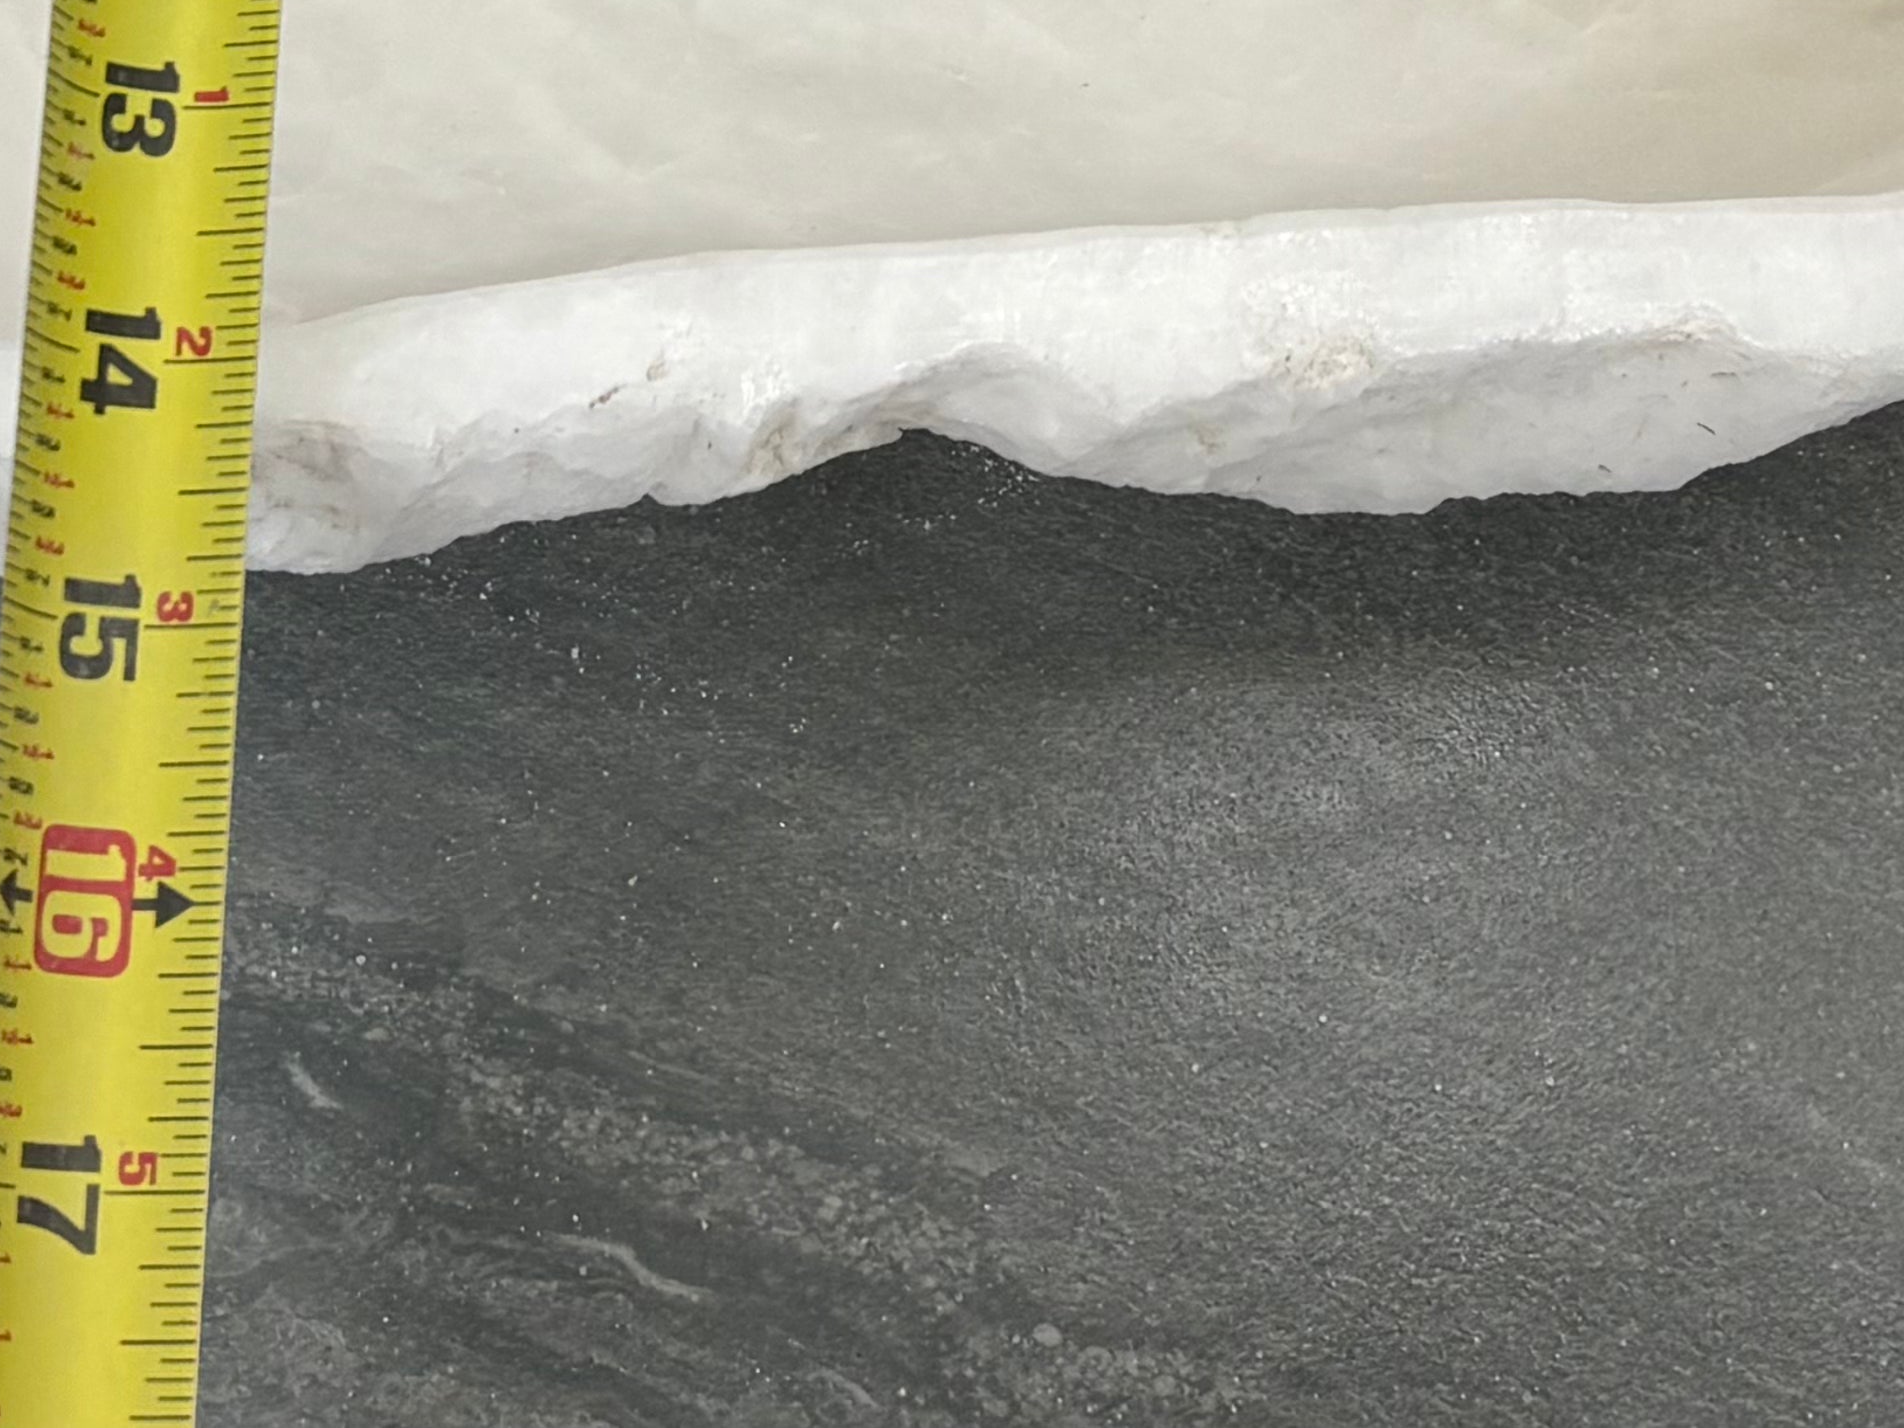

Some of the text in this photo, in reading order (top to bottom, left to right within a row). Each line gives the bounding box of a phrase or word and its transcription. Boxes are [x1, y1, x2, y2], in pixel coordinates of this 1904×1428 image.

[101, 61, 180, 157] 13
[194, 87, 230, 104] 1
[81, 307, 162, 415] 14
[175, 326, 212, 357] 2
[58, 573, 142, 682] 15
[157, 592, 194, 624] 3
[138, 845, 178, 882] 4
[41, 844, 126, 961] 16
[16, 1135, 102, 1255] 17
[118, 1151, 158, 1186] 5
